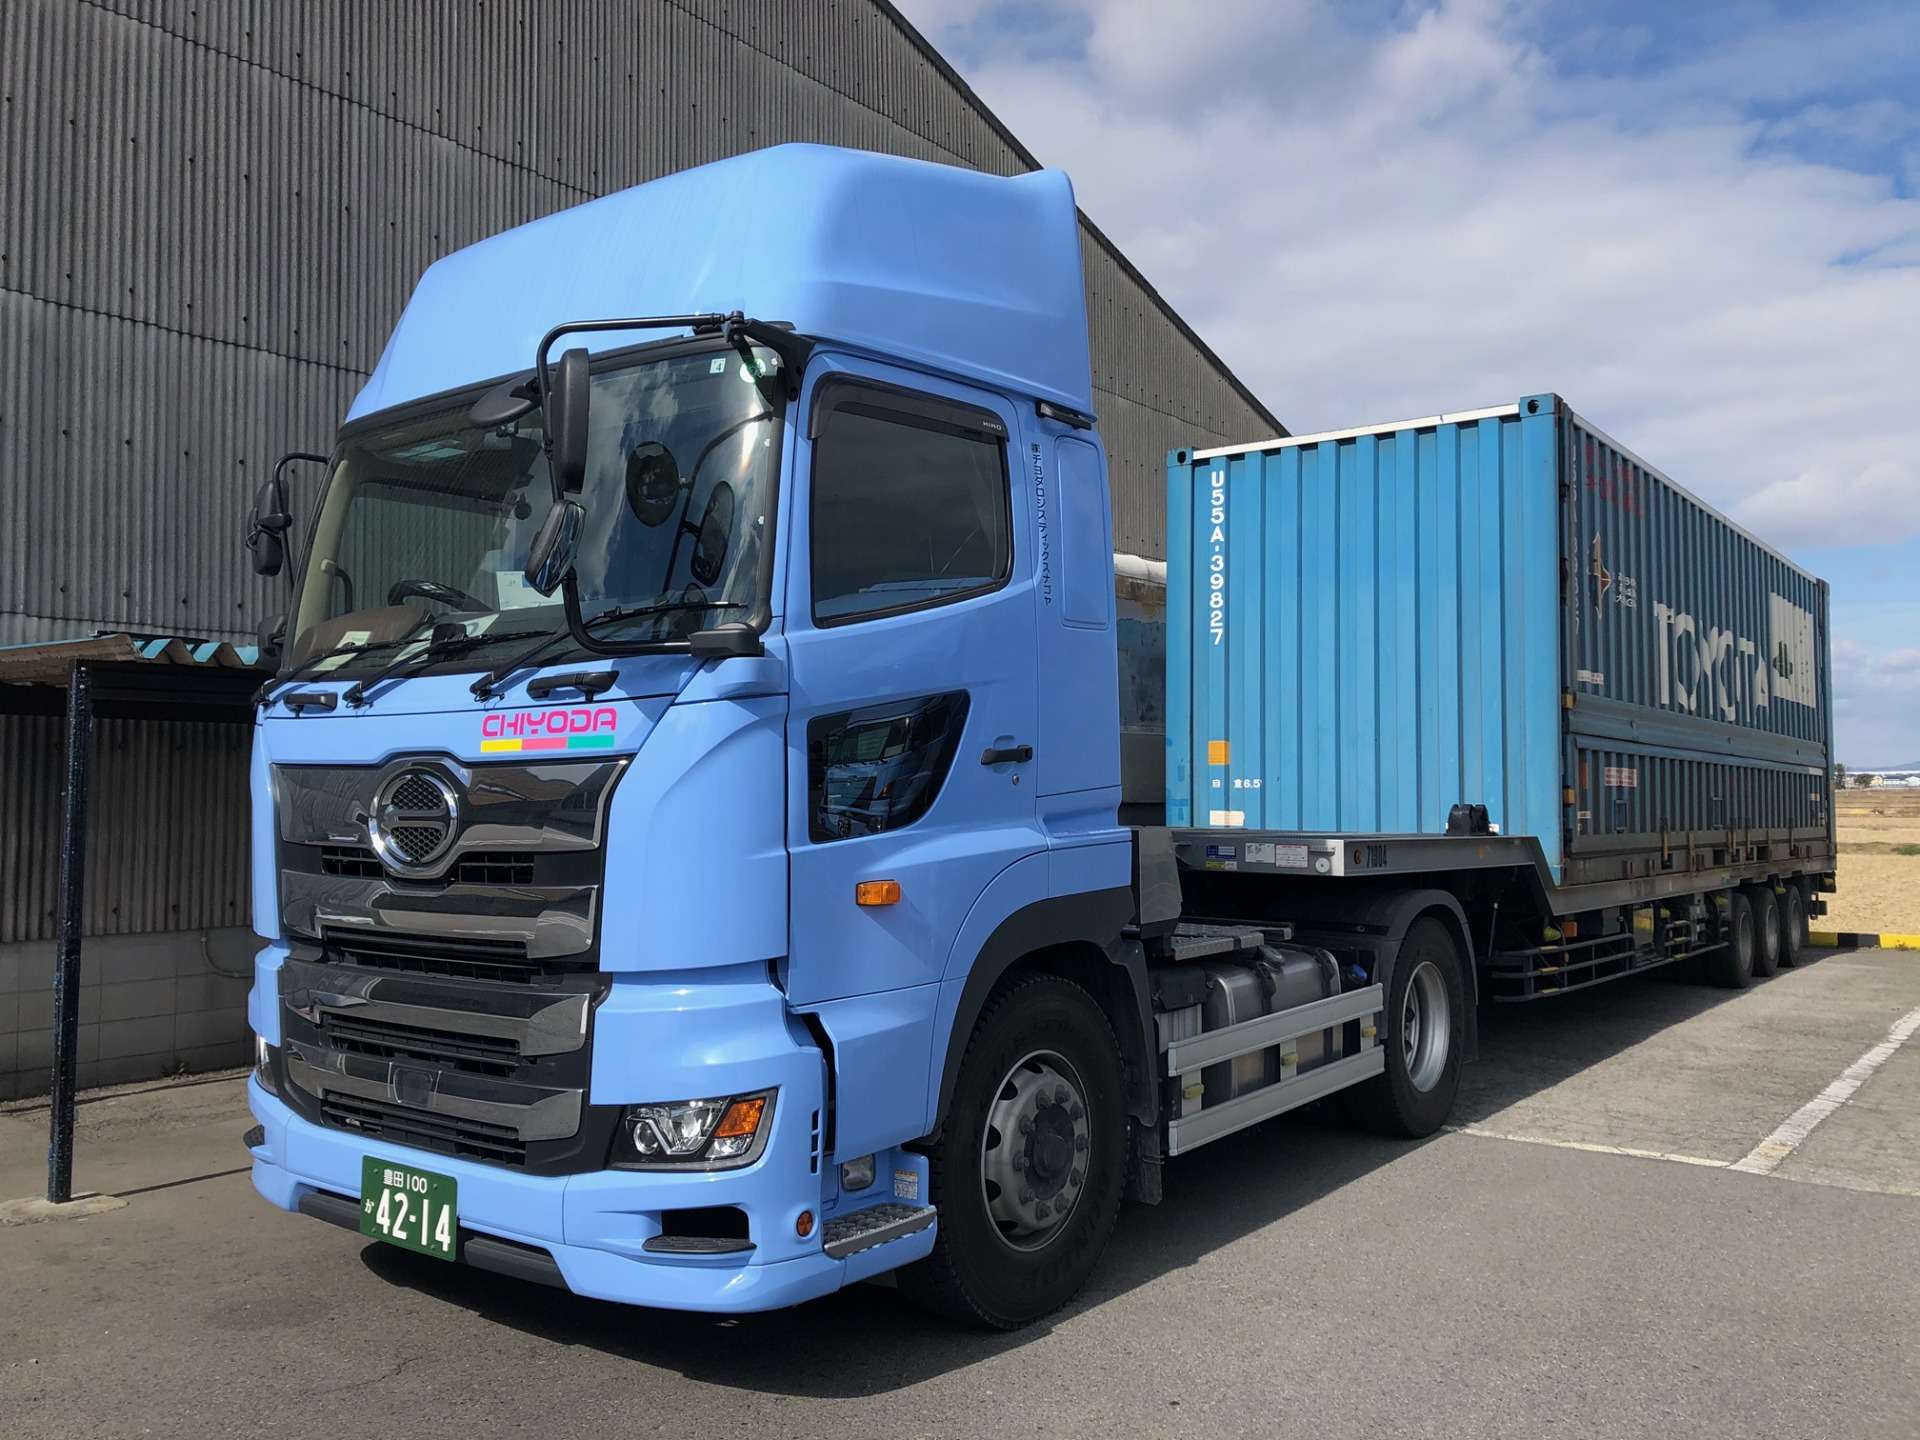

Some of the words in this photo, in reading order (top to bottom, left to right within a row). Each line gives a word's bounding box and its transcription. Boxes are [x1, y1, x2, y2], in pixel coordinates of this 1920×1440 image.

[482, 708, 617, 737] CHIYODA
[406, 1174, 428, 1194] 100
[376, 1188, 451, 1252] 42-14
